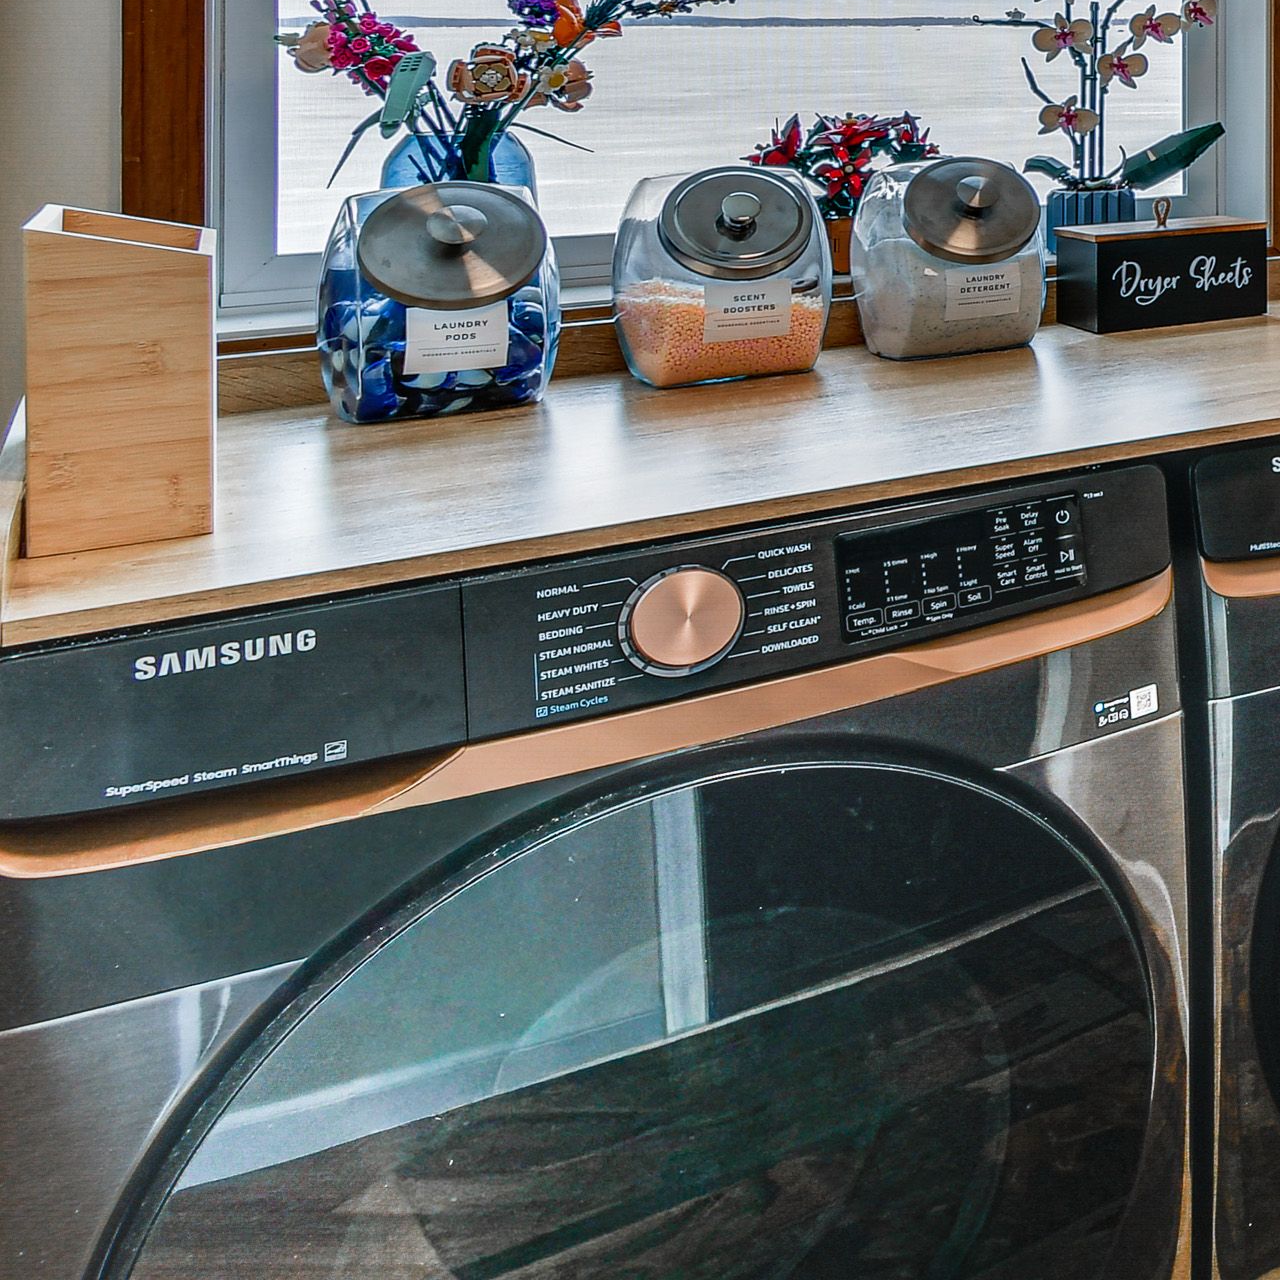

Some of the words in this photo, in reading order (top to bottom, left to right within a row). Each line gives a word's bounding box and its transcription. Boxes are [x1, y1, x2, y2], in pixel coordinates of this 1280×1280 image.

[966, 274, 1005, 283] LAUNDRY
[1112, 260, 1180, 306] Dryer
[1189, 255, 1253, 292] Sheets
[960, 283, 1010, 293] DETERGENT
[733, 293, 766, 302] SCENT
[723, 304, 776, 314] BOOSTERS
[434, 320, 488, 330] LAUNDRY
[445, 333, 477, 341] PODS
[994, 524, 1010, 532] Soak
[1023, 537, 1043, 546] Alarm
[758, 548, 784, 560] QUICK
[785, 543, 812, 556] WASH
[995, 543, 1013, 552] Super
[1028, 544, 1039, 553] Off
[995, 550, 1015, 560] Speed
[768, 564, 813, 579] DELICATES
[1025, 564, 1046, 573] Smart
[997, 570, 1017, 579] Smart
[1025, 571, 1048, 580] Control
[1000, 578, 1015, 586] Care
[536, 584, 580, 599] NORMAL
[782, 582, 815, 595] TOWELS
[967, 592, 982, 602] Soil
[931, 601, 947, 610] Spin
[538, 607, 570, 622] HEAVY
[572, 603, 599, 616] DUTY
[892, 607, 913, 618] Rinse
[853, 616, 876, 627] Temp.
[767, 621, 788, 634] SELF
[539, 625, 583, 641] BEDDING
[761, 635, 819, 653] DOWNLOADED
[134, 628, 317, 681] SAMSUNG
[539, 647, 572, 661] STEAM
[573, 639, 613, 656] NORMAL
[540, 666, 572, 680] STEAM
[574, 659, 609, 674] WHITES
[541, 686, 573, 700] STEAM
[574, 678, 616, 694] SANITIZE
[550, 700, 579, 715] Steam
[580, 694, 608, 711] Cycles
[105, 775, 189, 798] SuperSpeed
[193, 767, 237, 783] Steam
[241, 752, 318, 775] SmartThings
